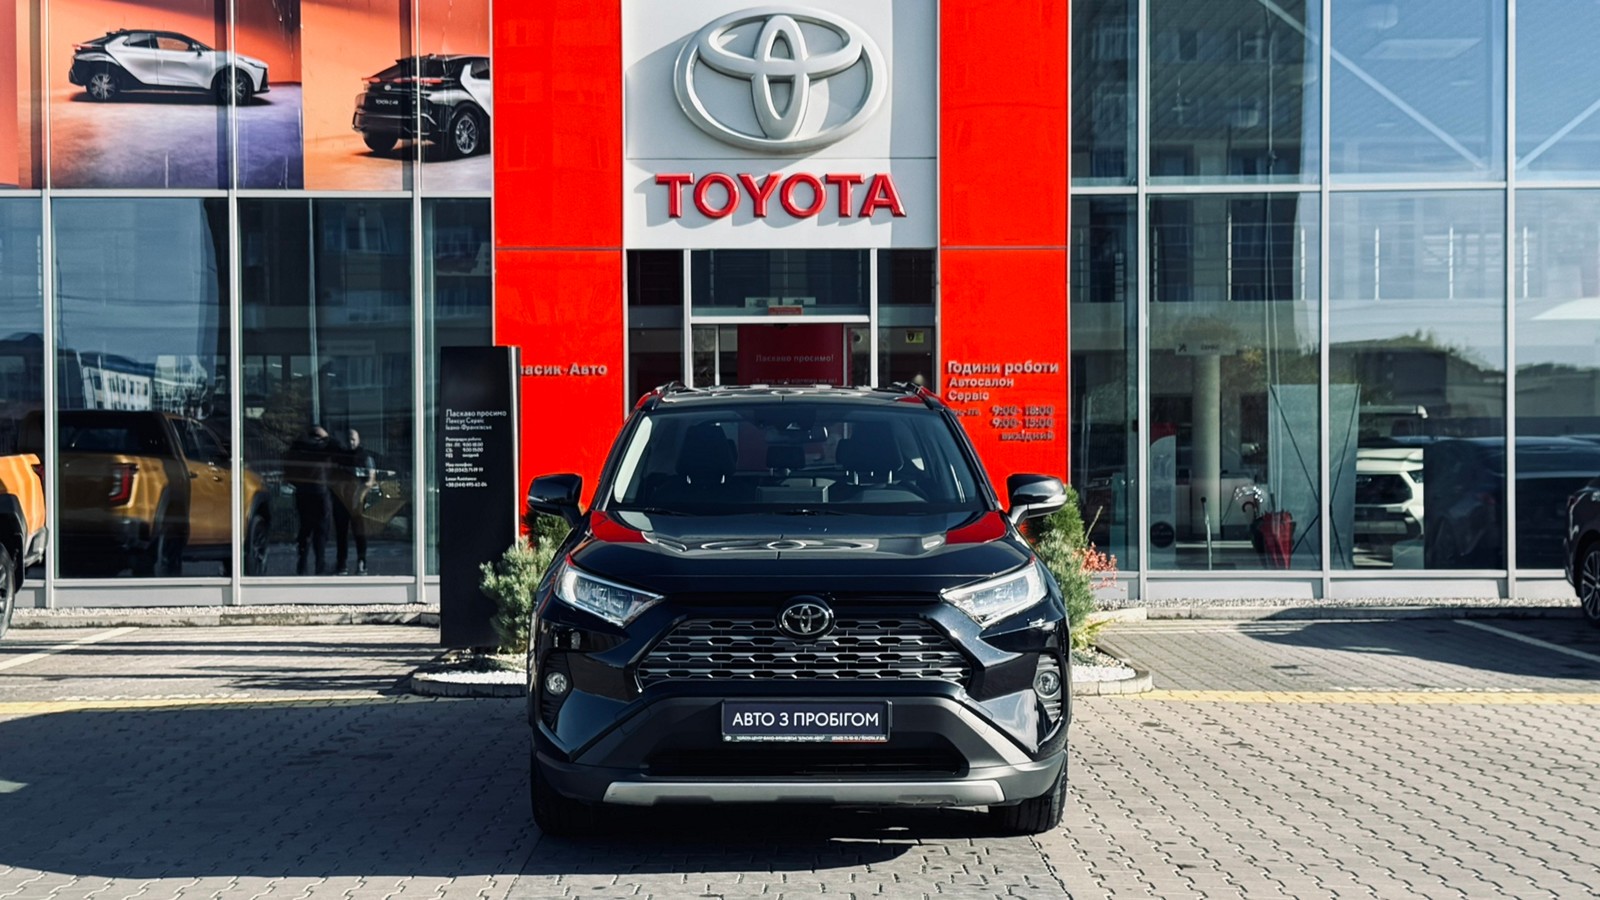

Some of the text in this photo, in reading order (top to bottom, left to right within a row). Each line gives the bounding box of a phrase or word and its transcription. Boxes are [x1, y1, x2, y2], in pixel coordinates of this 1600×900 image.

[655, 172, 907, 219] TOYOTA
[520, 362, 608, 376] асик-Авто
[947, 360, 1059, 376] Години роботи
[949, 377, 1014, 387] Автосалон
[732, 712, 879, 727] АВТО З ПРОБІГОМ
